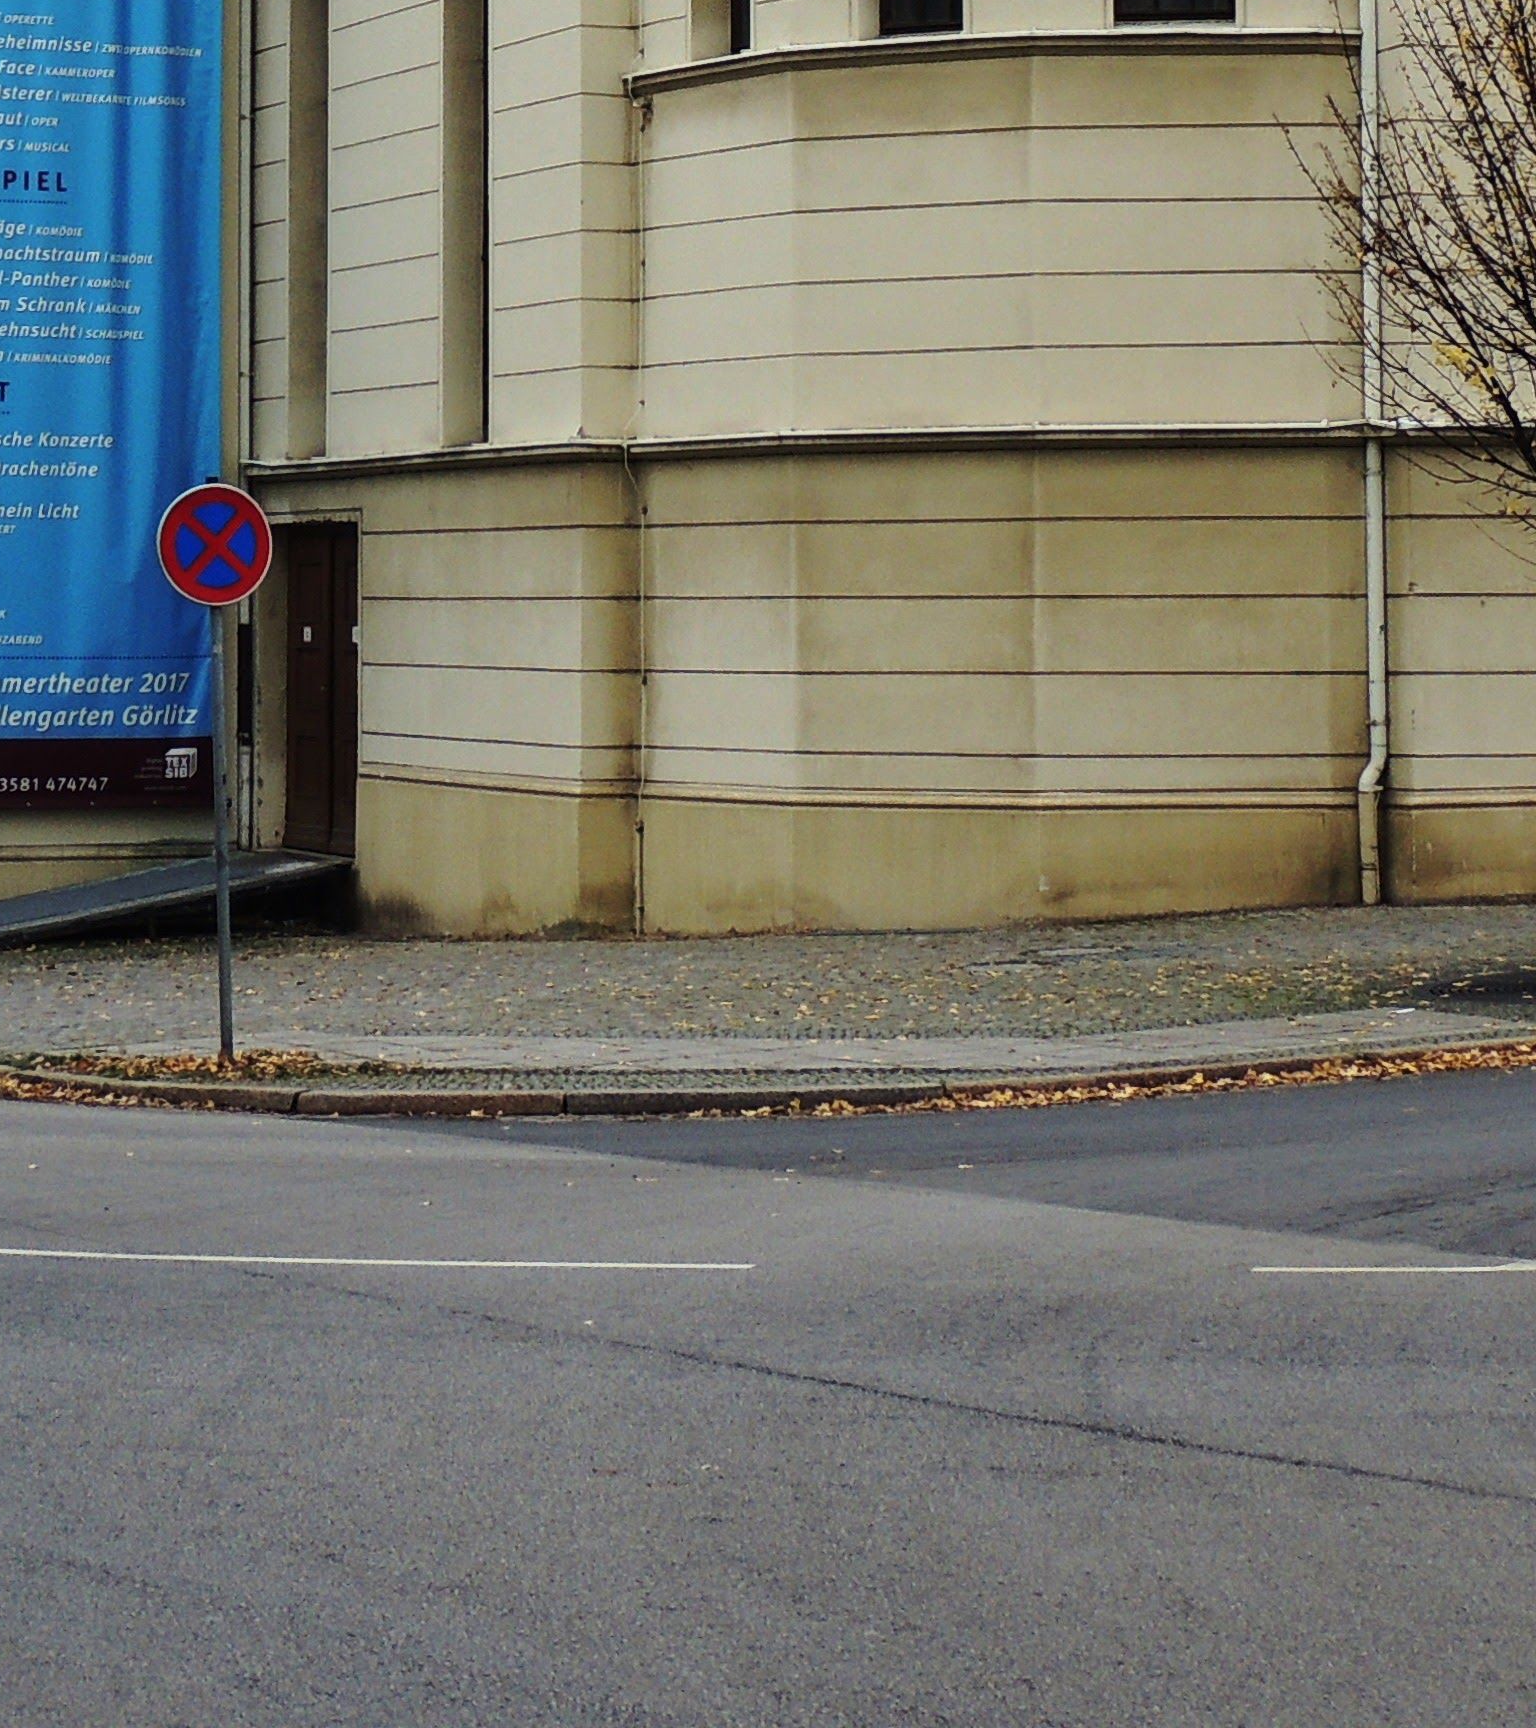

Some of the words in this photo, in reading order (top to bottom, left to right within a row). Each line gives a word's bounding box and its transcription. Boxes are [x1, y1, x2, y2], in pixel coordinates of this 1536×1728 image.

[4, 14, 55, 25] OPERETTE
[45, 66, 116, 78] KAMMEROPER
[31, 116, 59, 127] OPER
[23, 142, 70, 153] MUSICAL
[35, 225, 84, 237] KOMÖDIE
[15, 296, 87, 314] Schrank
[14, 352, 112, 365] KRIMINALKOMÖDIE
[38, 431, 114, 449] Konzerte
[38, 503, 80, 520] Licht
[139, 672, 190, 694] 2017
[122, 703, 199, 727] Görlitz
[45, 777, 109, 792] 474747
